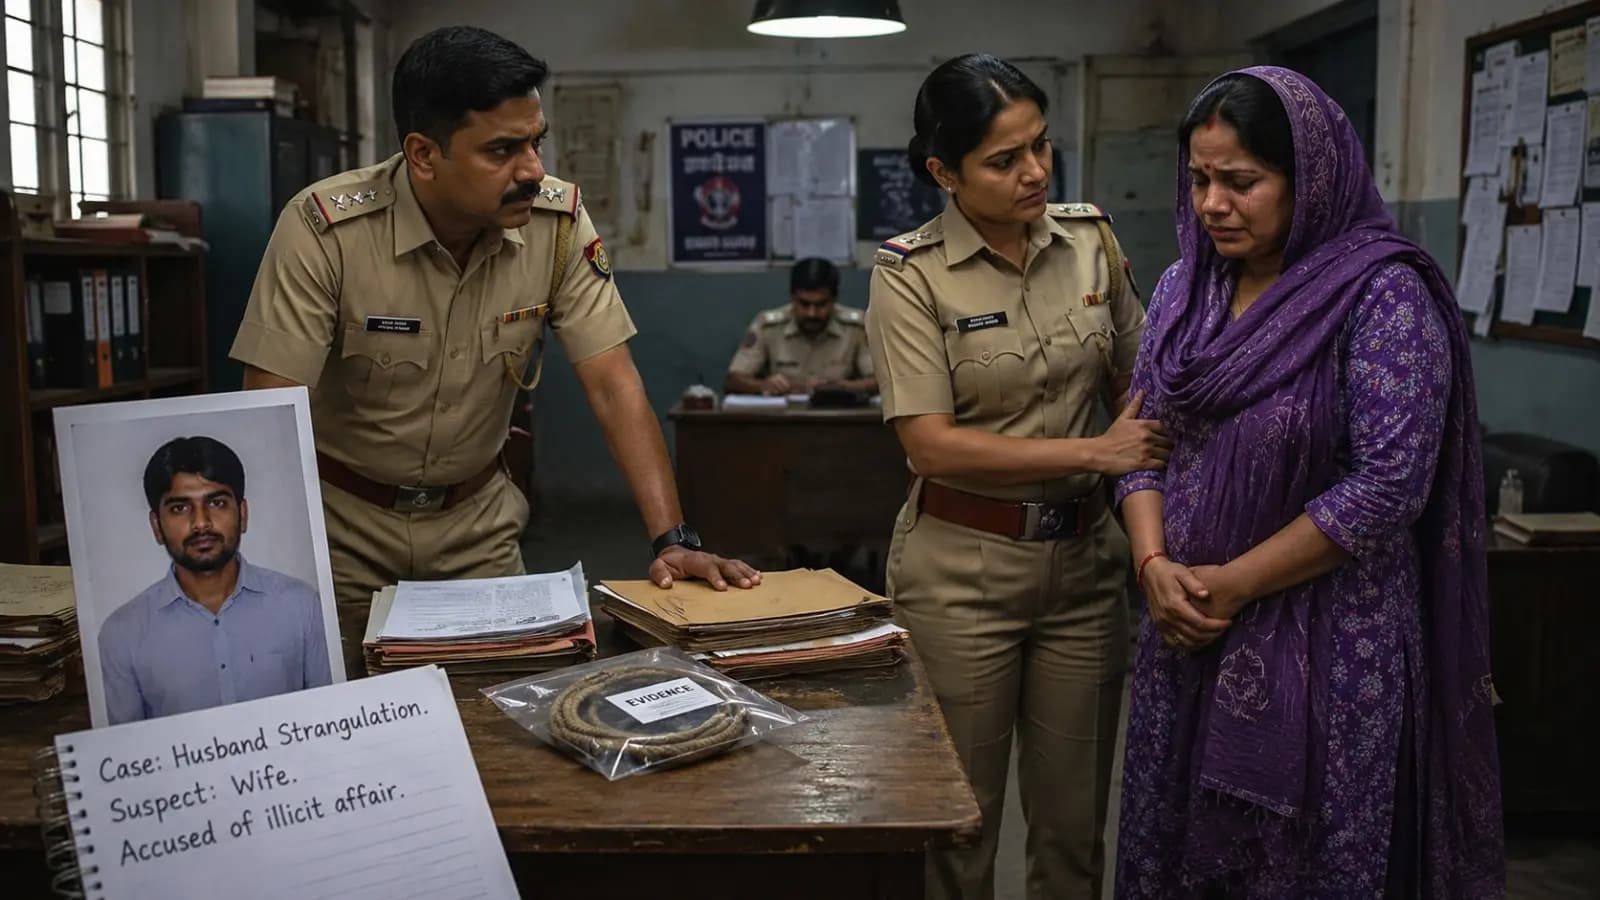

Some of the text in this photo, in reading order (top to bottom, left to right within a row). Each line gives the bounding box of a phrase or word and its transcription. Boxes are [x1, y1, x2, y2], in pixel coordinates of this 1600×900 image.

[681, 127, 755, 148] POLICE
[625, 684, 694, 707] EVIDENCE
[99, 700, 429, 783] Case: Husband Strangulation.
[110, 764, 297, 823] Suspect: Wife.
[120, 782, 405, 867] Accused of illicit affair.
